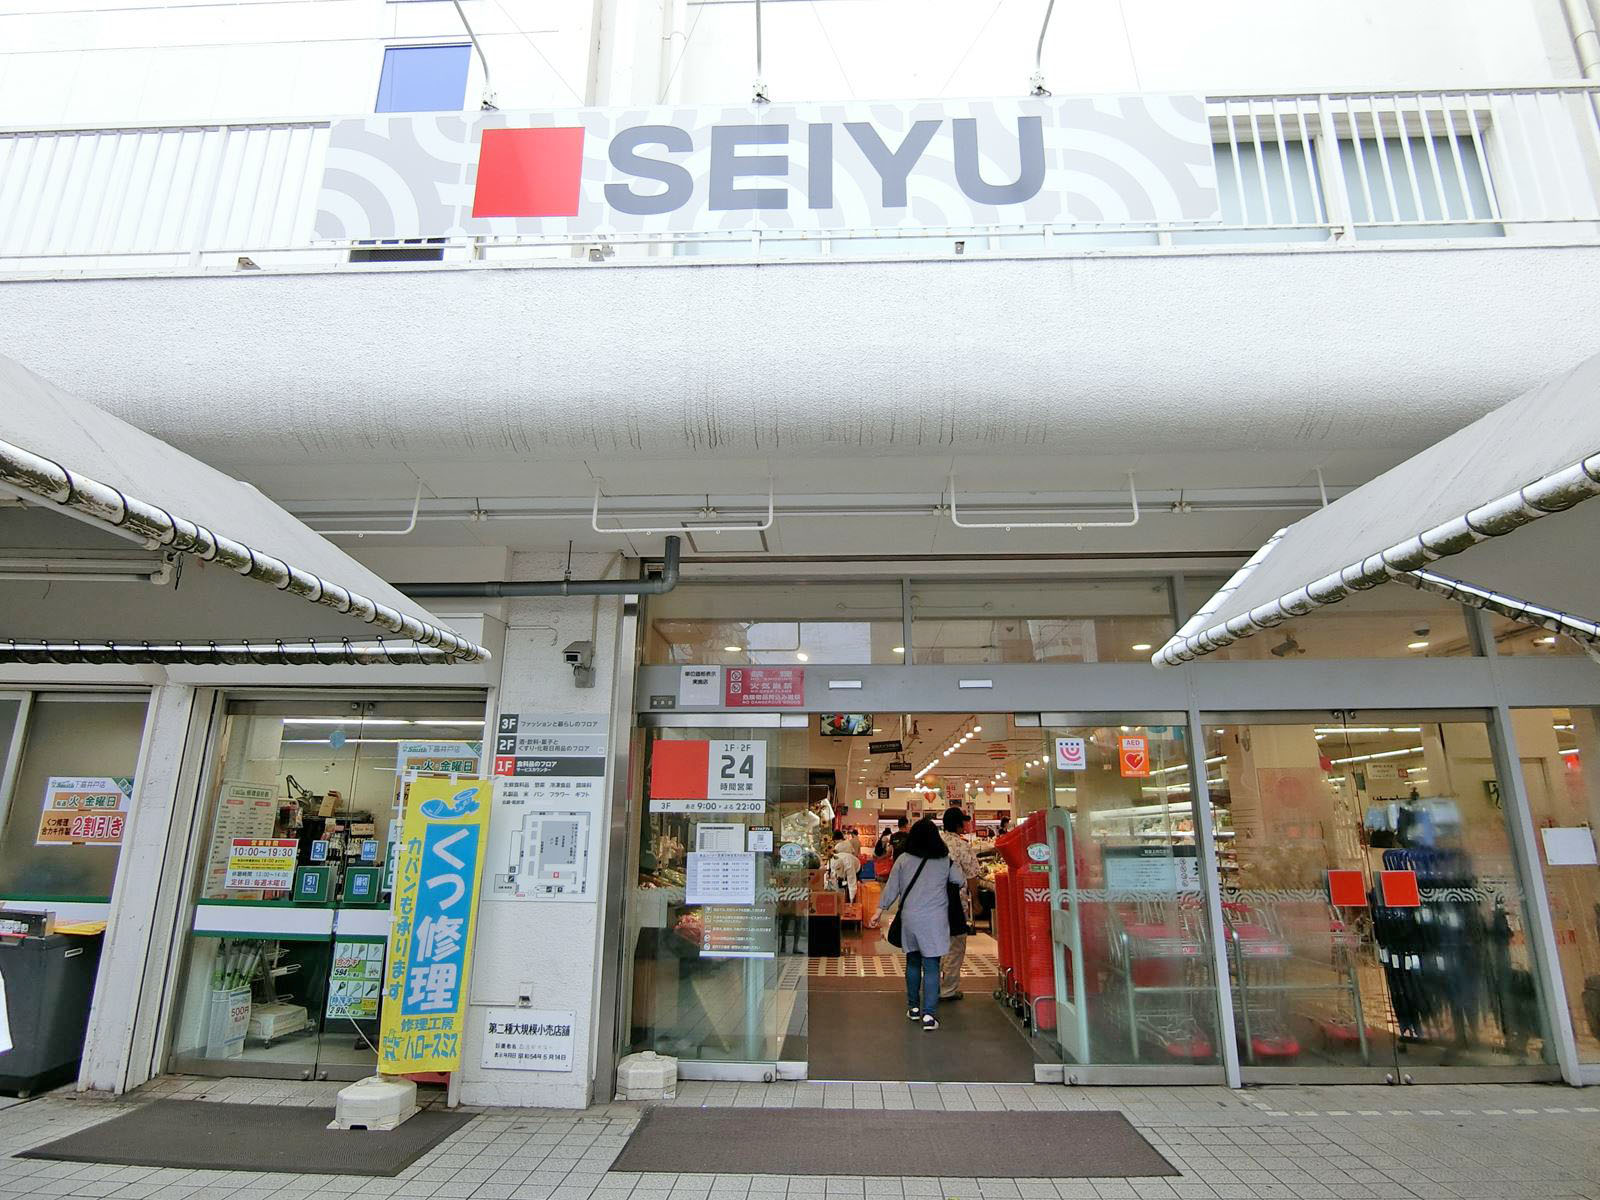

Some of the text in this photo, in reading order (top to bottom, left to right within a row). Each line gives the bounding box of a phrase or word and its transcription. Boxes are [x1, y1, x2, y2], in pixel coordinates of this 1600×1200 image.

[603, 115, 1047, 215] SEIYU
[501, 718, 516, 730] 3F
[500, 740, 514, 750] 2F
[498, 761, 512, 772] 1F
[721, 754, 754, 778] 24
[720, 783, 753, 791] 時間営業
[68, 796, 116, 806] 火・金曜日
[72, 817, 122, 838] 2割引き
[388, 837, 421, 1000] カバンも承ります
[407, 828, 470, 1011] くつ修理
[402, 1017, 454, 1032] 修理工房
[488, 1022, 570, 1036] 第二種大規模小売店舗
[404, 1033, 457, 1060] ハロースミス
